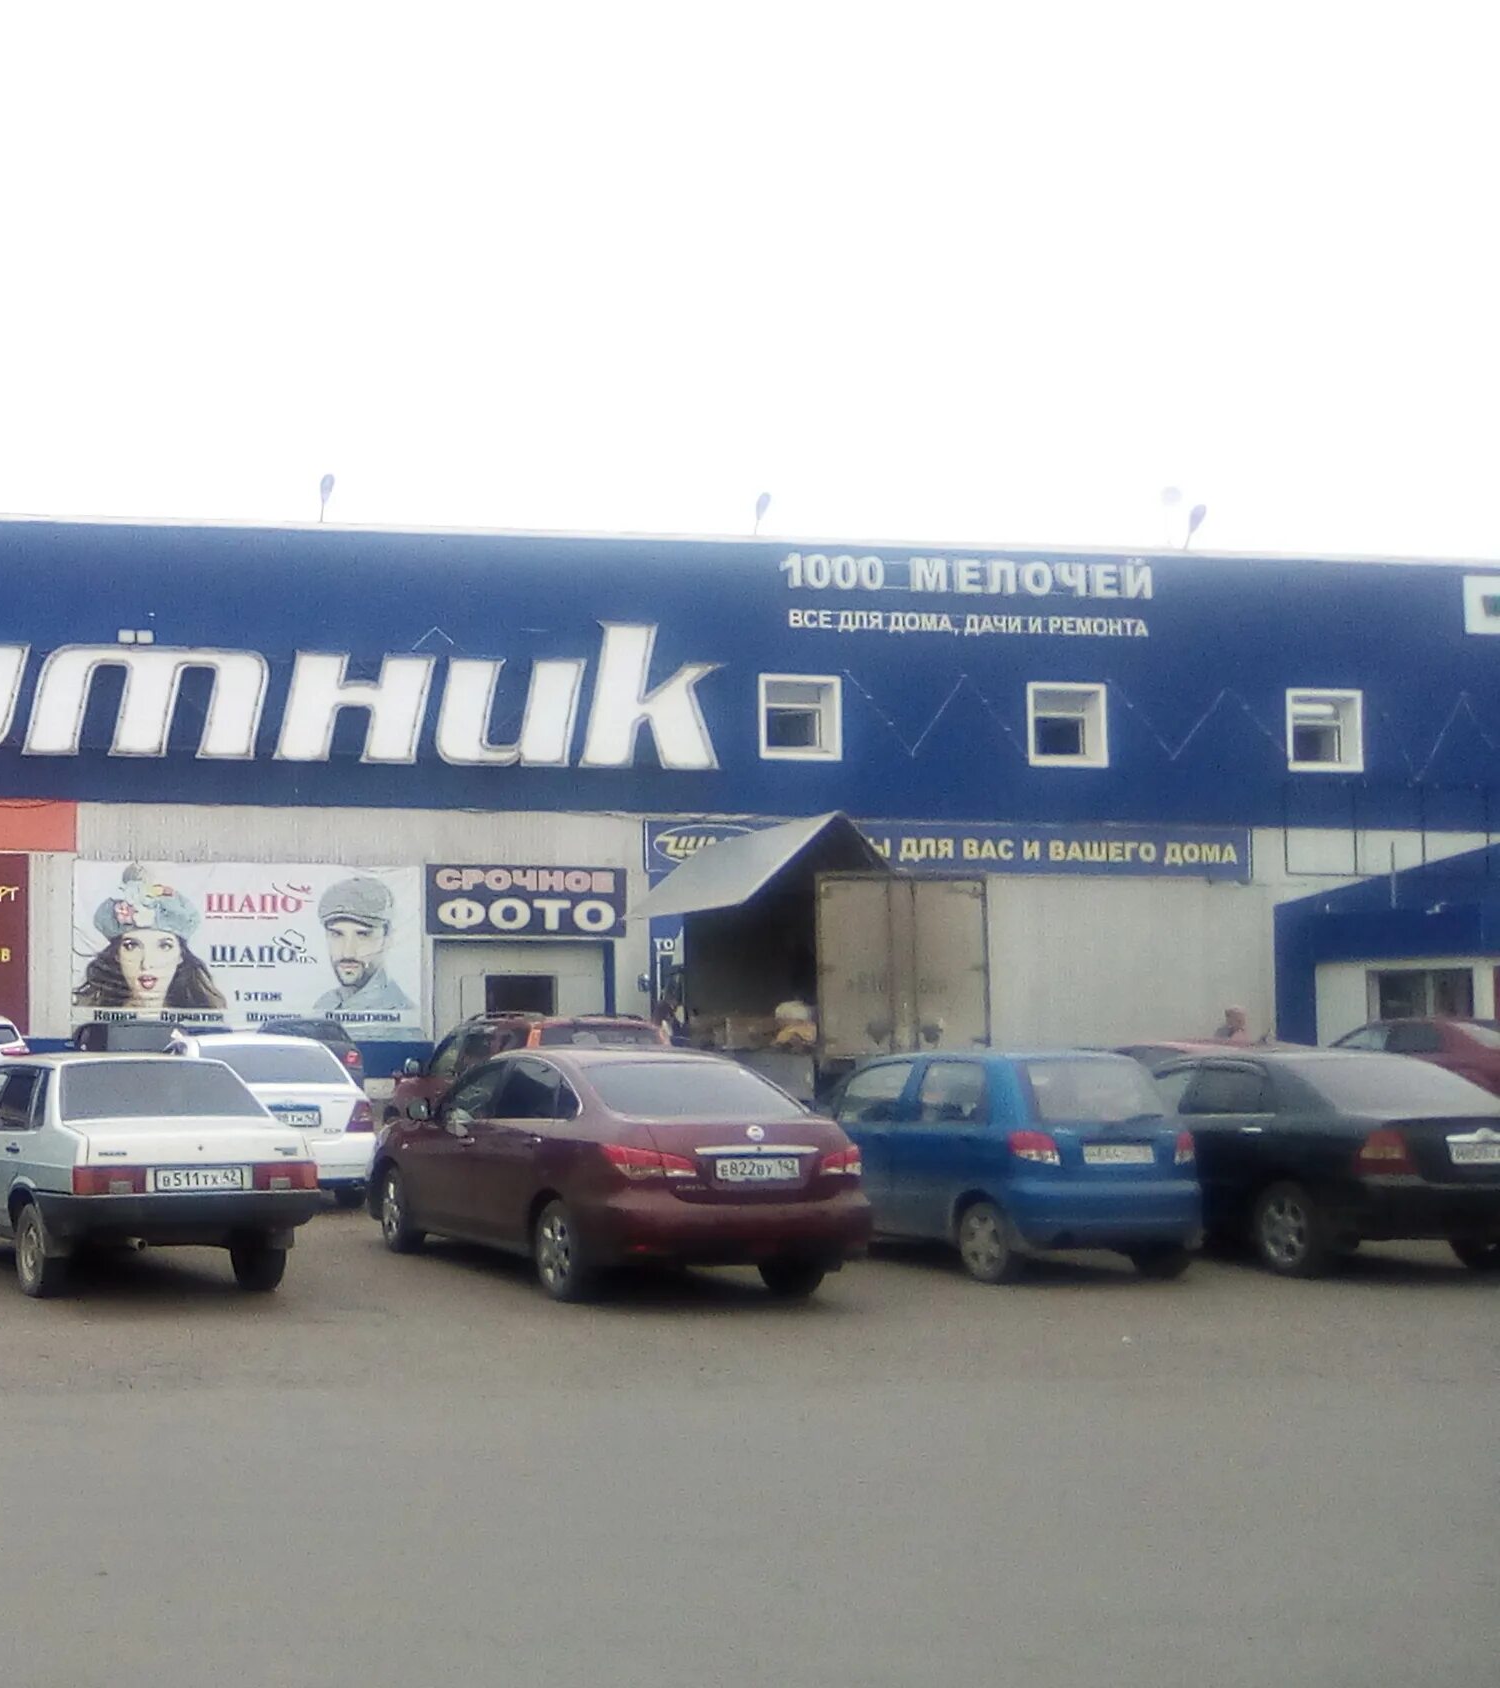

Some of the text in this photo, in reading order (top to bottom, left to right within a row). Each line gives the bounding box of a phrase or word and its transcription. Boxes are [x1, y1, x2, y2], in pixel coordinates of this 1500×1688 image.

[780, 552, 1153, 599] 1000 МЕЛОЧЕЙ
[788, 608, 1150, 637] ВСЕ ДЛЯ ДОМА, ДАЧИ И РЕМОНТА
[899, 838, 954, 863] ДЛЯ
[962, 838, 1015, 861] ВАС
[1023, 840, 1041, 861] И
[1049, 839, 1157, 863] ВАШЕГО
[1164, 842, 1239, 866] ДОМА
[435, 868, 615, 893] СРОЧНОЕ
[437, 898, 617, 932] ФОТО
